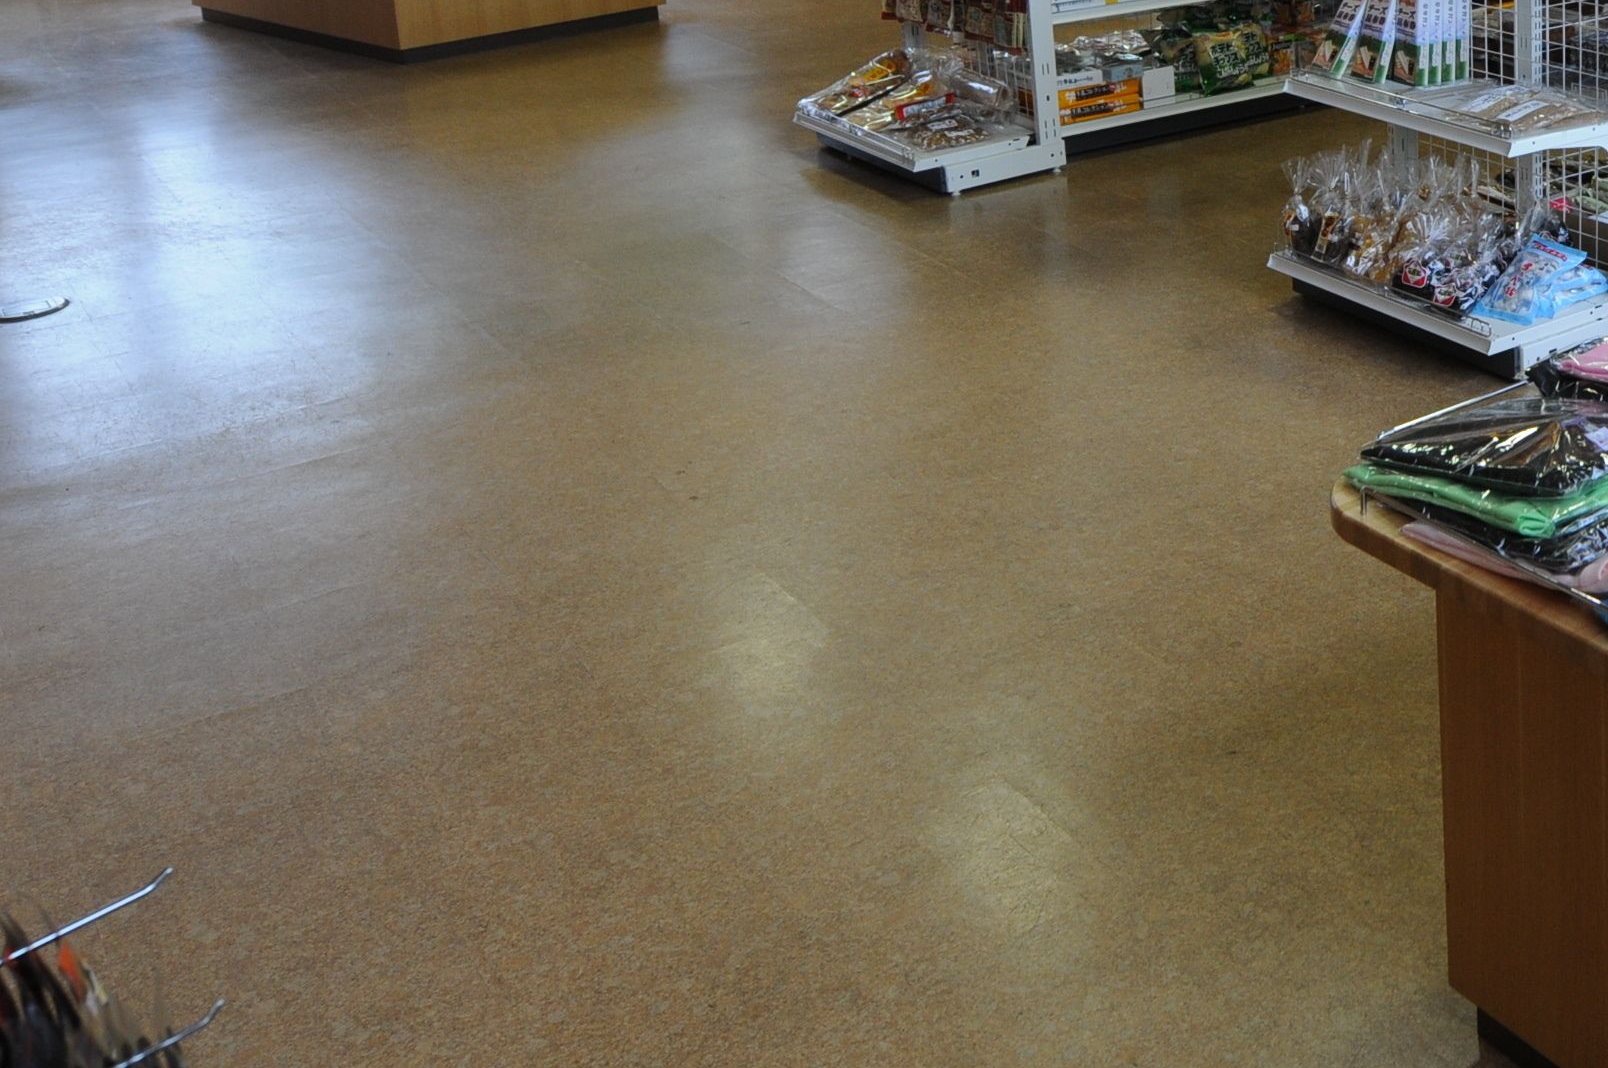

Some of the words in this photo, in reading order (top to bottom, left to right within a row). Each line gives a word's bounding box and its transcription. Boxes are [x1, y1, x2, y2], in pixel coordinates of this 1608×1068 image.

[1367, 4, 1388, 15] チーズ
[1398, 7, 1416, 19] チーズ
